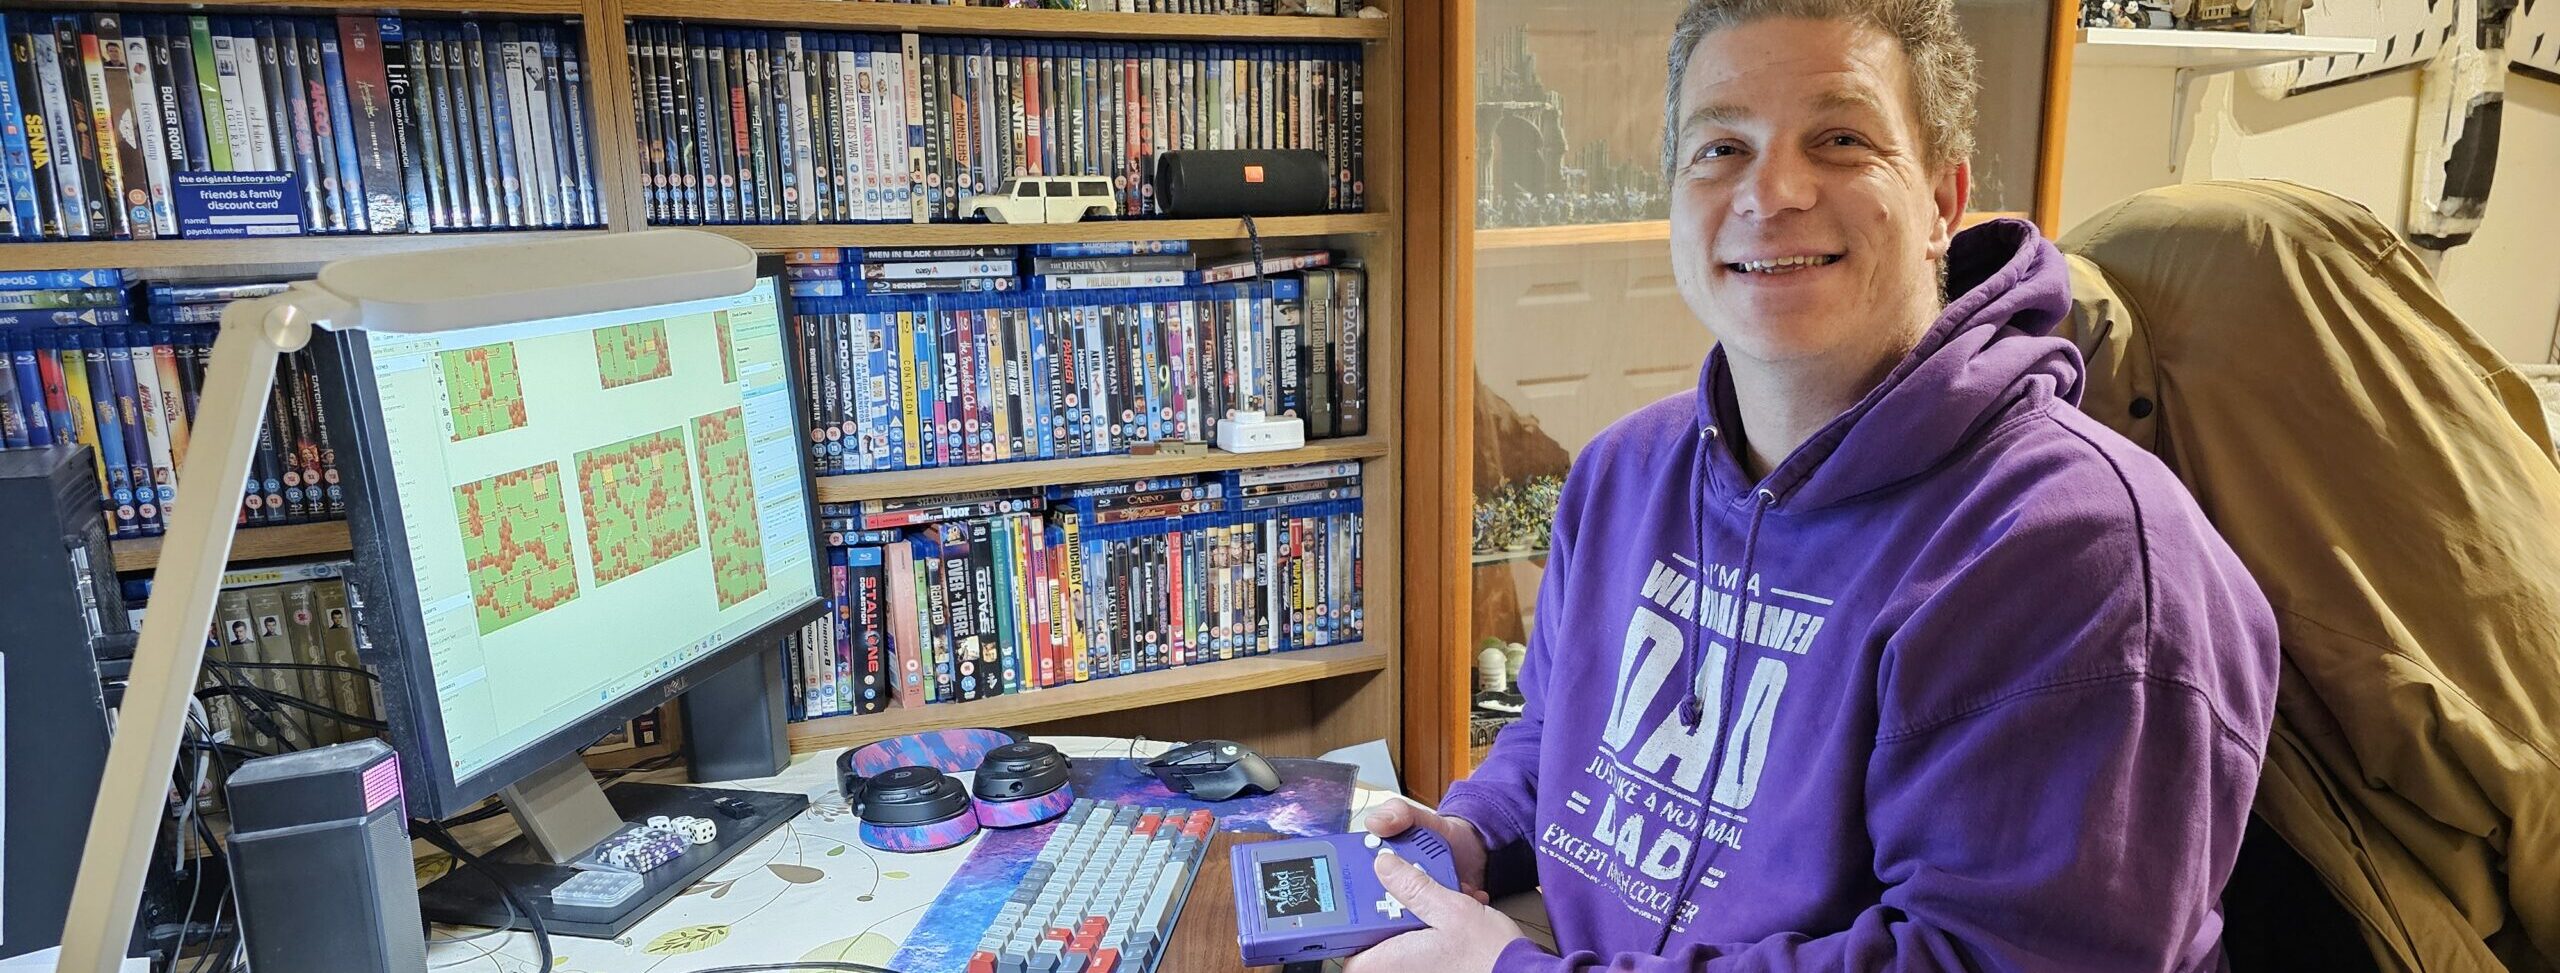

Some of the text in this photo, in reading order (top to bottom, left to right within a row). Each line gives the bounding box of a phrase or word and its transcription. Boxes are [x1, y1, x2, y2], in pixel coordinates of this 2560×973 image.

[387, 64, 409, 95] Life
[658, 76, 674, 115] ALIENS
[674, 61, 689, 133] ALIEN
[908, 69, 920, 118] BABY DRIVER
[1154, 88, 1164, 115] FALLING
[90, 73, 111, 150] TRINITY THE
[161, 86, 183, 160] BOILER ROOM
[309, 80, 331, 137] ARGO
[437, 87, 450, 122] wonders
[456, 87, 474, 160] wonders solar
[829, 92, 840, 147] AM LEGEND
[843, 74, 859, 158] CHARLIE WILSON'S WAR
[922, 74, 937, 166] CLOVERFIELD
[999, 99, 1008, 150] SOLOMON
[1012, 83, 1024, 153] WANTED
[1027, 114, 1040, 137] ZULU
[1115, 82, 1125, 169] STAR TREK DARKNESS
[1128, 102, 1139, 144] ROUNDERS
[1340, 85, 1350, 168] ROBIN HOOD
[25, 114, 50, 169] SENNA
[140, 102, 160, 160] Forrest Gump
[224, 99, 240, 158] FIGURES
[235, 110, 246, 146] HIDDEN
[393, 99, 409, 167] DAVID ATTENBOROUGH
[697, 96, 710, 169] PROMETHEUS
[778, 103, 792, 167] STRANDED
[861, 95, 875, 172] BRIDGET JONES'S BABY
[955, 113, 968, 161] MONSTERS
[1072, 109, 1083, 162] IN TIME
[1102, 119, 1110, 155] HOME
[1354, 112, 1362, 159] DUNE
[178, 175, 288, 184] the original factory shop
[200, 190, 282, 201] friends & family
[184, 217, 208, 225] name:
[207, 200, 279, 210] discount card
[186, 227, 215, 236] payroll
[216, 227, 245, 235] number:
[869, 250, 931, 259] MEN IN BLACK
[1062, 260, 1108, 270] IRISHMAN
[1086, 276, 1131, 287] PHILADELPHIA
[1204, 340, 1213, 369] LETHAL
[1312, 299, 1326, 373] BAND BROTHERS
[1343, 280, 1357, 384] THE PACIFIC
[861, 363, 868, 372] An
[960, 341, 977, 411] the Breakfast Club
[975, 334, 988, 387] HIROKIN
[1021, 351, 1029, 371] ROMEO
[1063, 339, 1074, 384] PARKER
[1078, 349, 1088, 390] HANCOCK
[1090, 350, 1100, 372] AKIRA
[1107, 346, 1118, 395] HITMAN
[1132, 348, 1143, 386] ROCK
[1225, 316, 1235, 394] TERMINATOR
[1285, 329, 1297, 387] ROSS KEMP
[824, 374, 832, 412] VALOUR
[839, 339, 853, 417] DOOMSDAY
[887, 350, 899, 410] LE MANS
[903, 360, 913, 416] CONTAGION
[943, 353, 958, 403] PAUL
[1007, 360, 1020, 396] STAR TREK
[1049, 353, 1062, 410] TOTAL RECALL
[163, 391, 175, 424] MARVEL
[311, 375, 329, 446] CATCHING FIRE
[857, 383, 865, 423] PILKINGTON
[260, 428, 271, 448] ONE
[917, 490, 999, 506] SHADOW MAKERS
[1073, 484, 1129, 498] INSURGENT
[1127, 493, 1165, 504] CASINO
[1277, 492, 1322, 504] THE ACCOUNTANT
[908, 506, 970, 523] Right Door
[947, 559, 964, 591] OVER
[1068, 532, 1081, 586] IDIOCRACY
[1144, 562, 1152, 578] Last
[1710, 563, 1760, 597] I'M A
[930, 585, 944, 625] REDACTED
[975, 568, 989, 635] SPACED
[1051, 585, 1062, 623] FAHRENHEIT
[1293, 559, 1302, 609] PULP FICTION
[865, 576, 879, 673] STALLONE
[951, 600, 968, 637] THERE
[1108, 586, 1117, 631] BEACHES
[1121, 629, 1127, 639] 60
[824, 658, 831, 667] 8
[663, 676, 689, 698] DELL
[1602, 604, 1789, 810] DAD
[1644, 792, 1656, 812] A
[1542, 822, 1610, 870] EXCEPT
[1593, 793, 1692, 881] DAD
